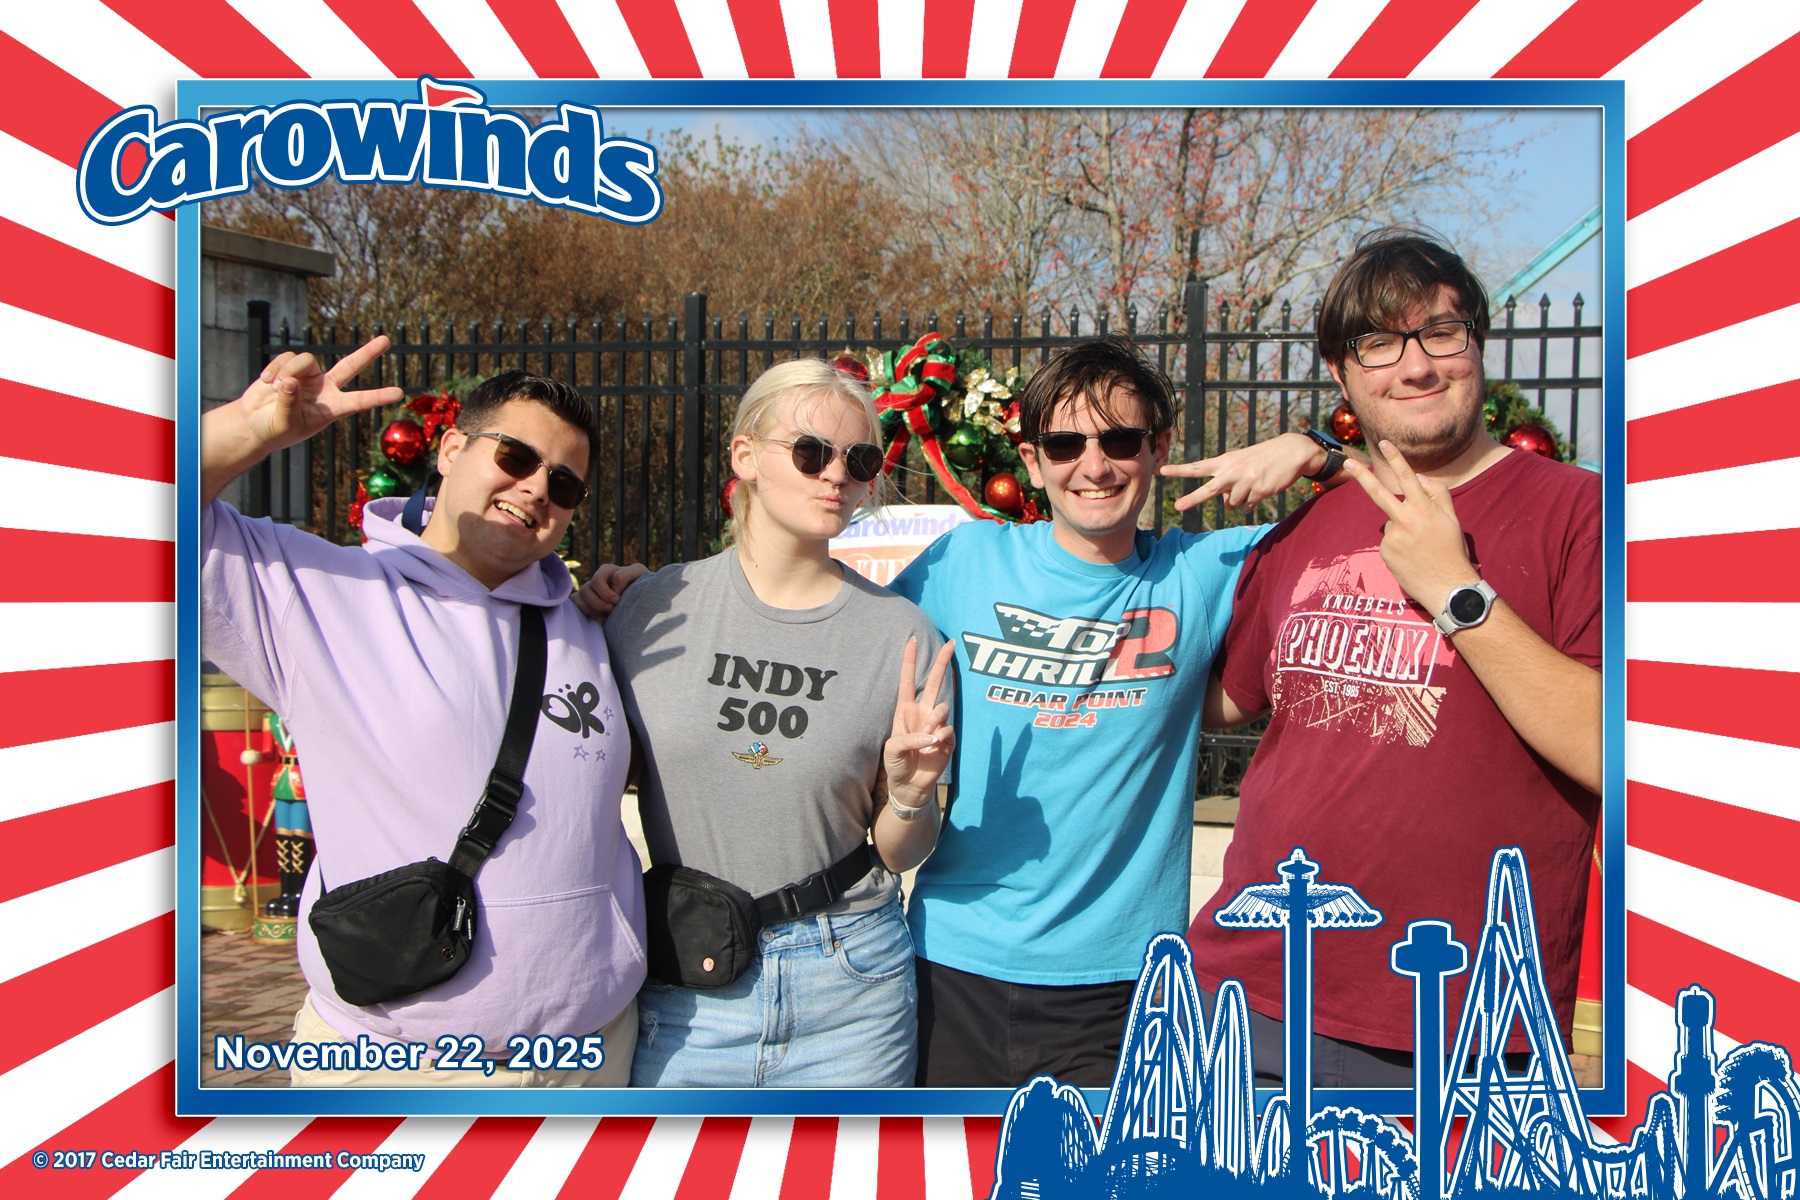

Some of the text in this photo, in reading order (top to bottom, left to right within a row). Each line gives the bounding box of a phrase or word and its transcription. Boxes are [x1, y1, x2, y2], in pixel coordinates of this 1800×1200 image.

[1322, 594, 1407, 616] KNOEBELS
[1108, 606, 1178, 681] 2
[1285, 618, 1429, 681] PHOENIX
[707, 652, 838, 701] INDY
[986, 684, 1148, 711] CEDAR POINT
[717, 697, 809, 739] 500
[1033, 712, 1098, 729] 2024
